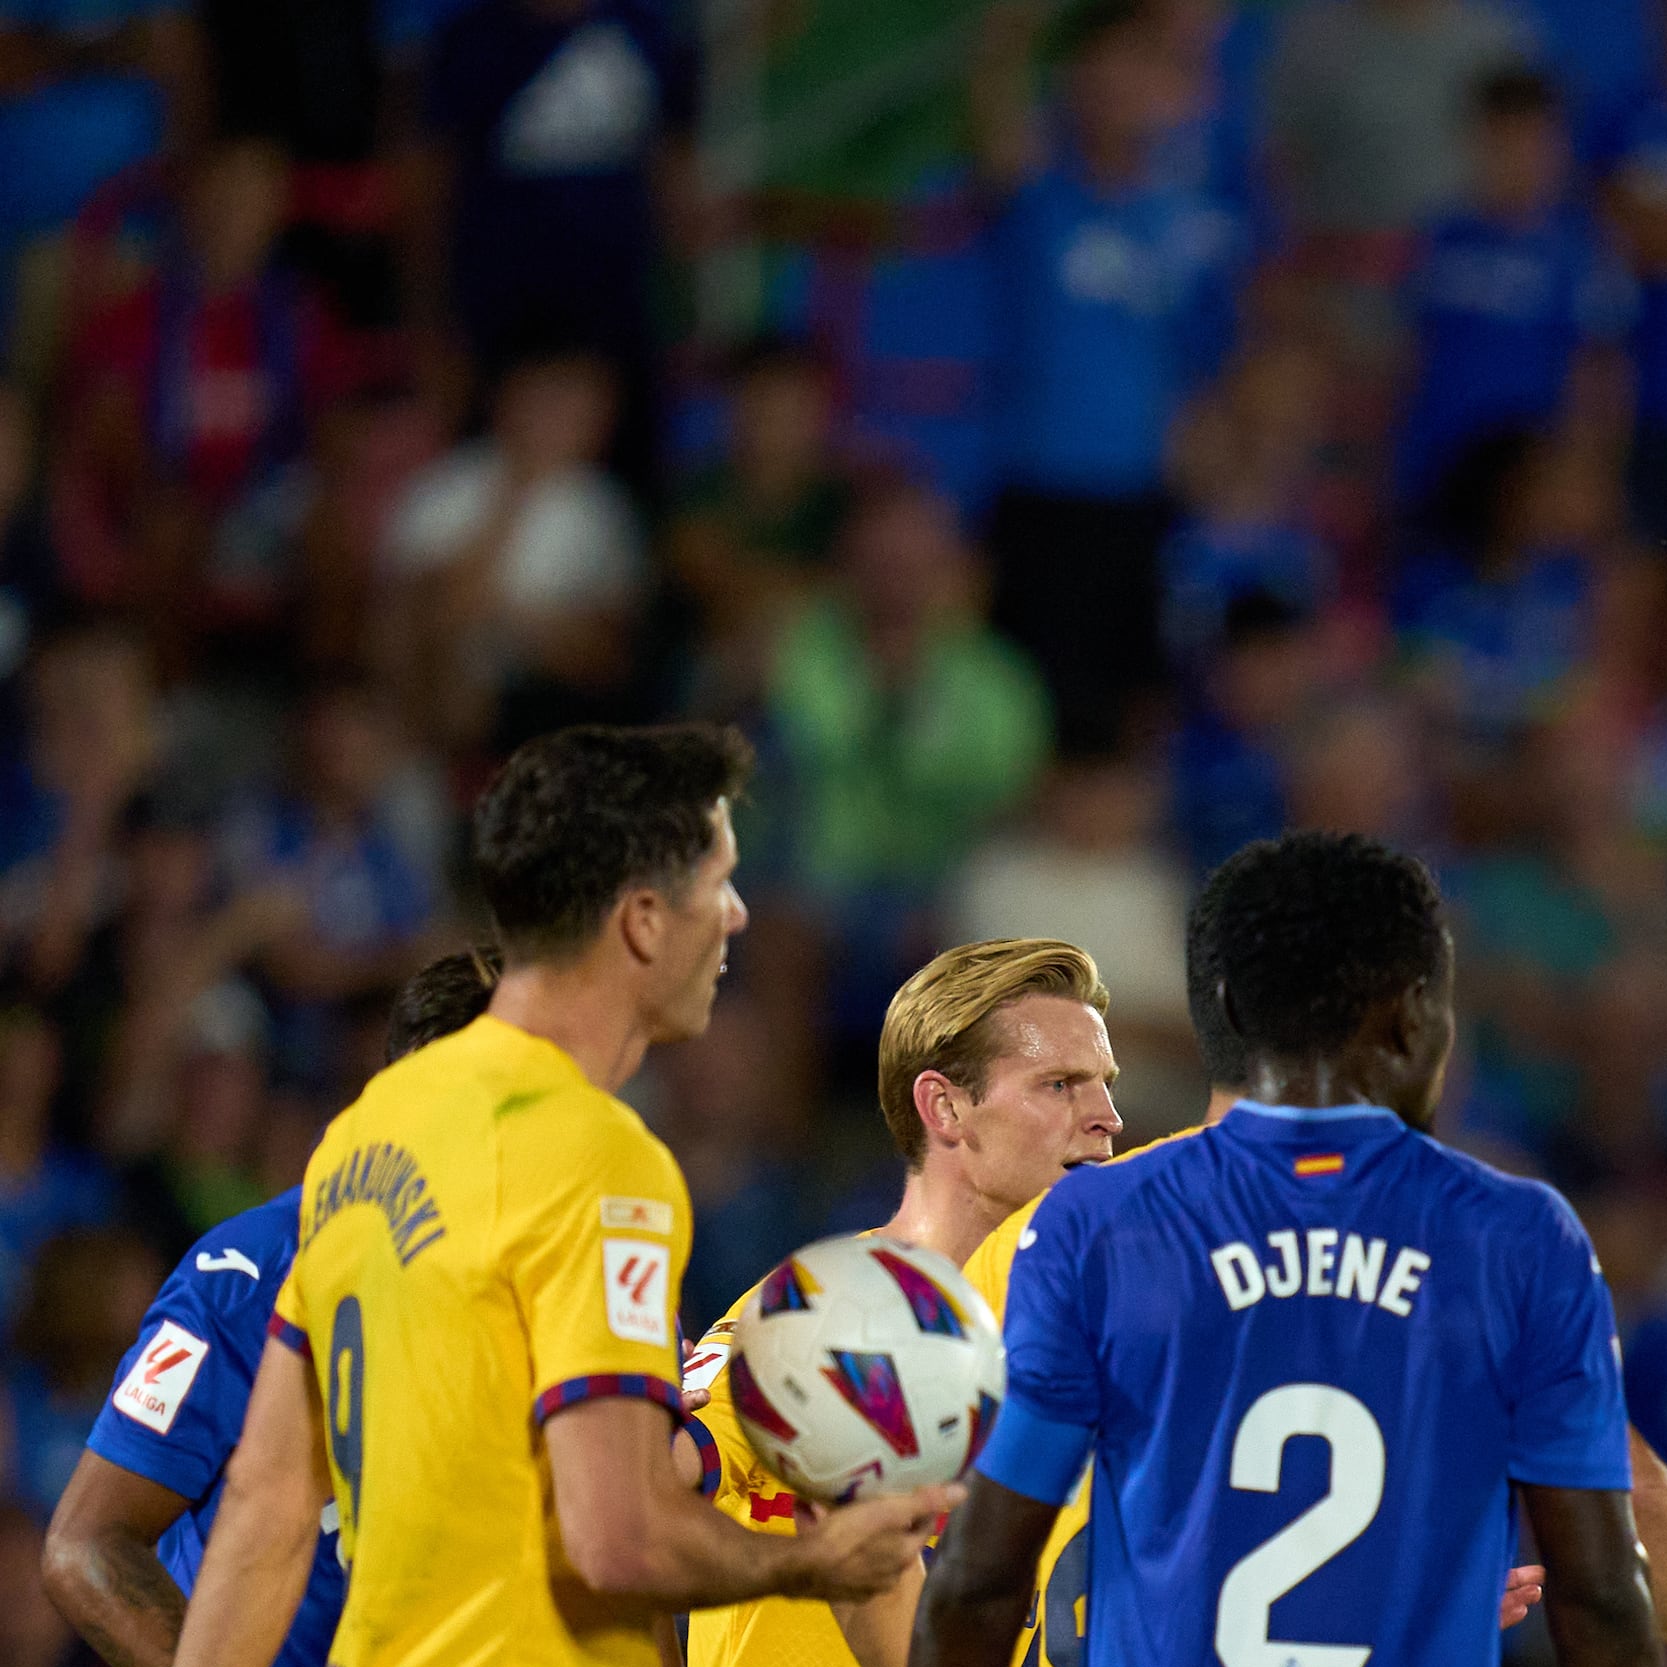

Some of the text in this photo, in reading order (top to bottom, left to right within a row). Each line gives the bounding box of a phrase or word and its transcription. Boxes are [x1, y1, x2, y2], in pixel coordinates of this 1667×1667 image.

[1210, 1228, 1431, 1317] DJENE
[123, 1383, 167, 1416] LALIGA
[329, 1295, 365, 1532] 9
